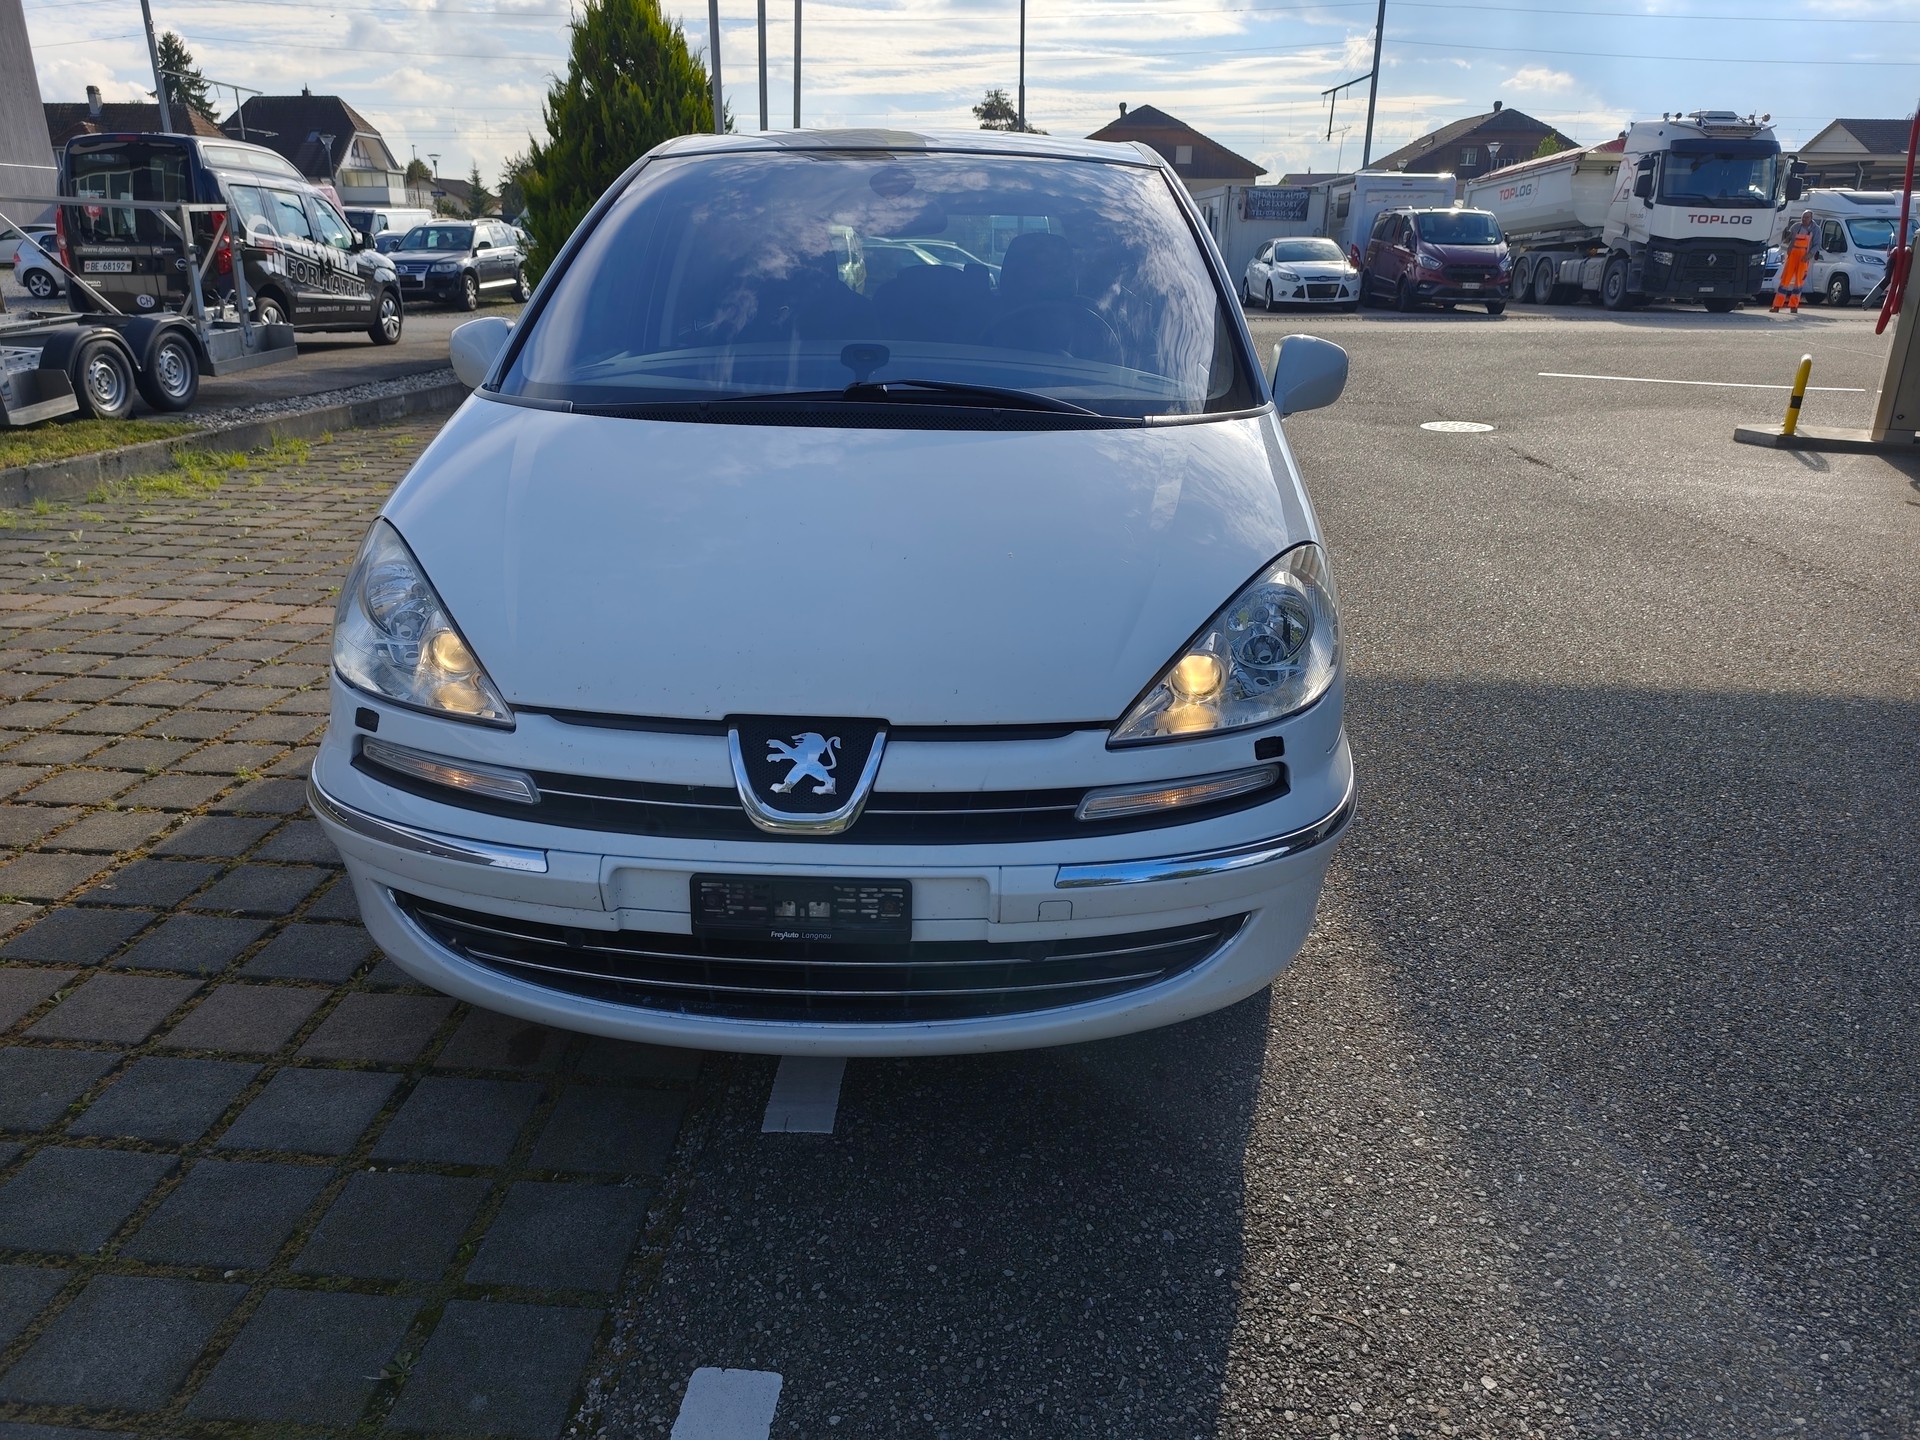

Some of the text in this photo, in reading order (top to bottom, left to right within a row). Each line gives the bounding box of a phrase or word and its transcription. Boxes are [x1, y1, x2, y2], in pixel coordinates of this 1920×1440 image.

[1262, 191, 1284, 199] KAUFE
[1286, 191, 1309, 199] AUTOS
[1499, 184, 1533, 200] TOPLOG
[1688, 214, 1752, 225] TOPLOG
[82, 246, 130, 254] www.gilomen.ch
[140, 296, 152, 306] CH
[771, 931, 832, 940] FreyAuto Langnau
